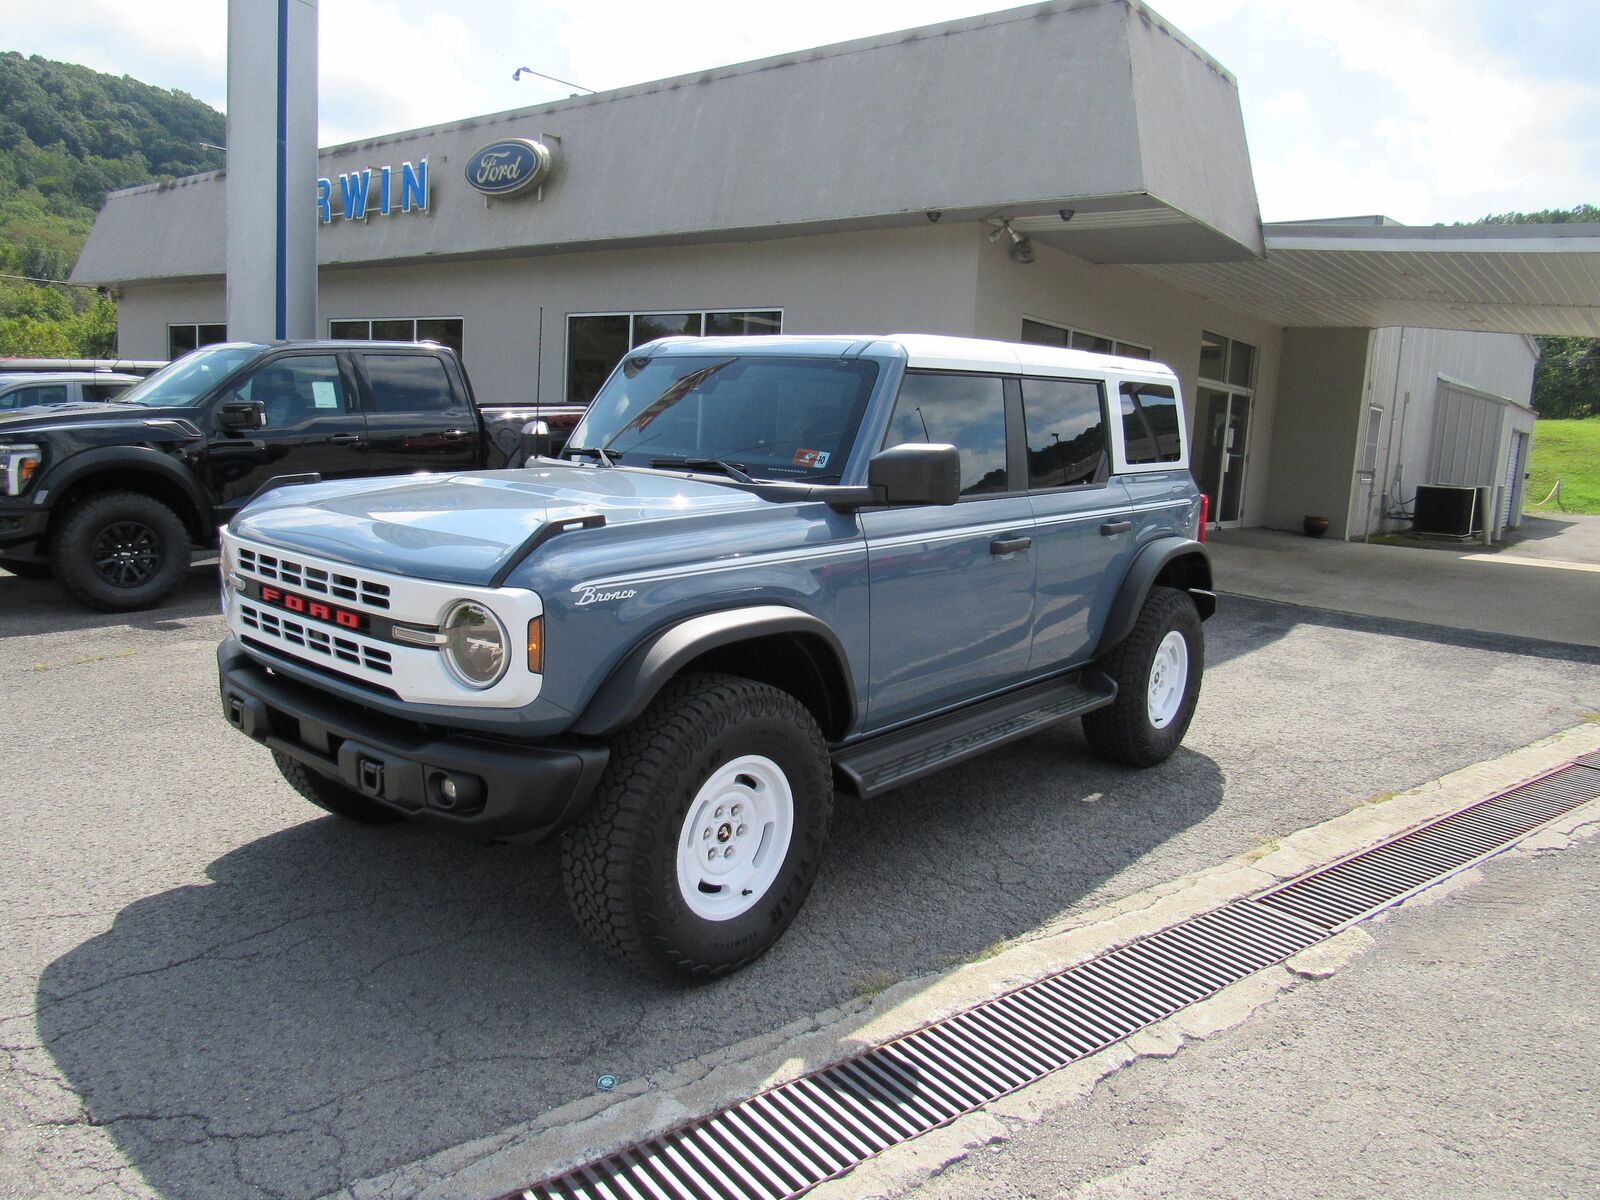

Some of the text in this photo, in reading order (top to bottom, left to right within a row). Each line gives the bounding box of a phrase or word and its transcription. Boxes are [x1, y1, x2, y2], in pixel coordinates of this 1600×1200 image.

[477, 152, 522, 183] Ford
[262, 587, 361, 629] FORD
[574, 586, 637, 606] Bronco
